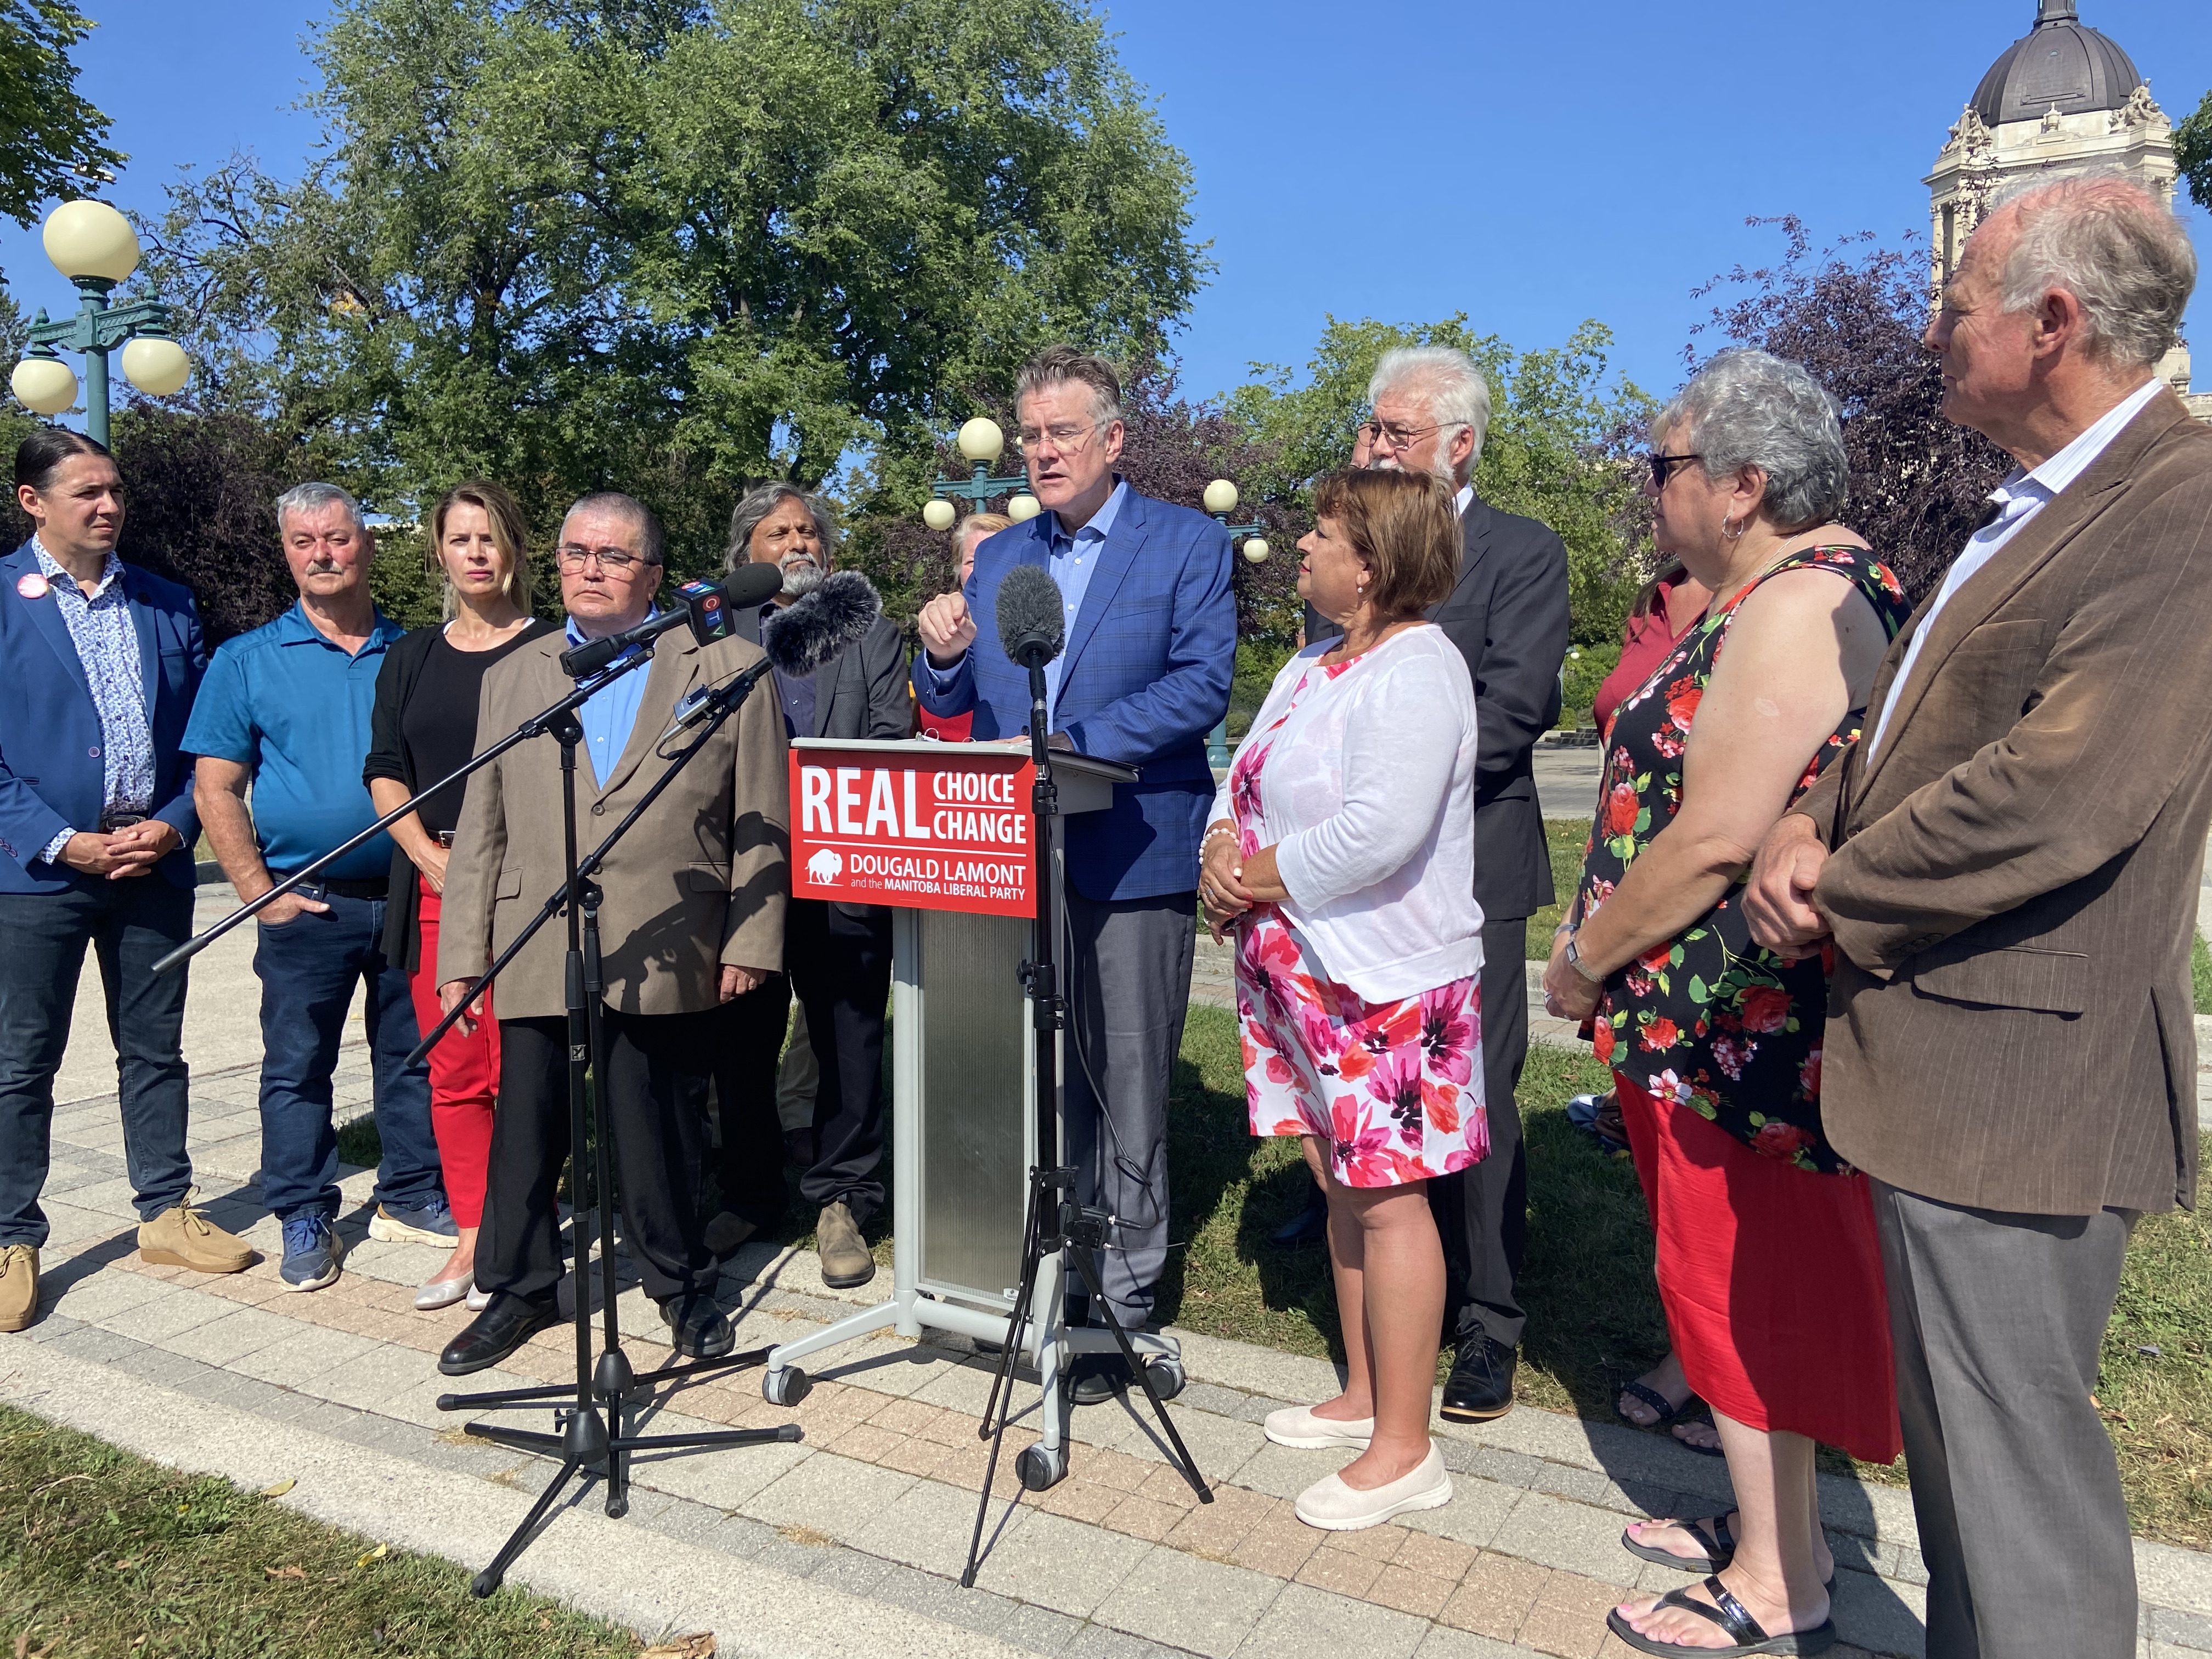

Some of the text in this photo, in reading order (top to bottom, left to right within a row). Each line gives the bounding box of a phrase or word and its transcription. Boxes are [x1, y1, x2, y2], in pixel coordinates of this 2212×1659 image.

[683, 582, 715, 594] CTV
[704, 597, 724, 636] CTV
[801, 765, 930, 839] REAL
[933, 771, 1015, 803] CHOICE
[933, 810, 1026, 844] CHANGE
[850, 854, 1026, 886] DOUGALD LAMONT
[850, 877, 1026, 901] and the MANITOBA LIBERAL PARTY
